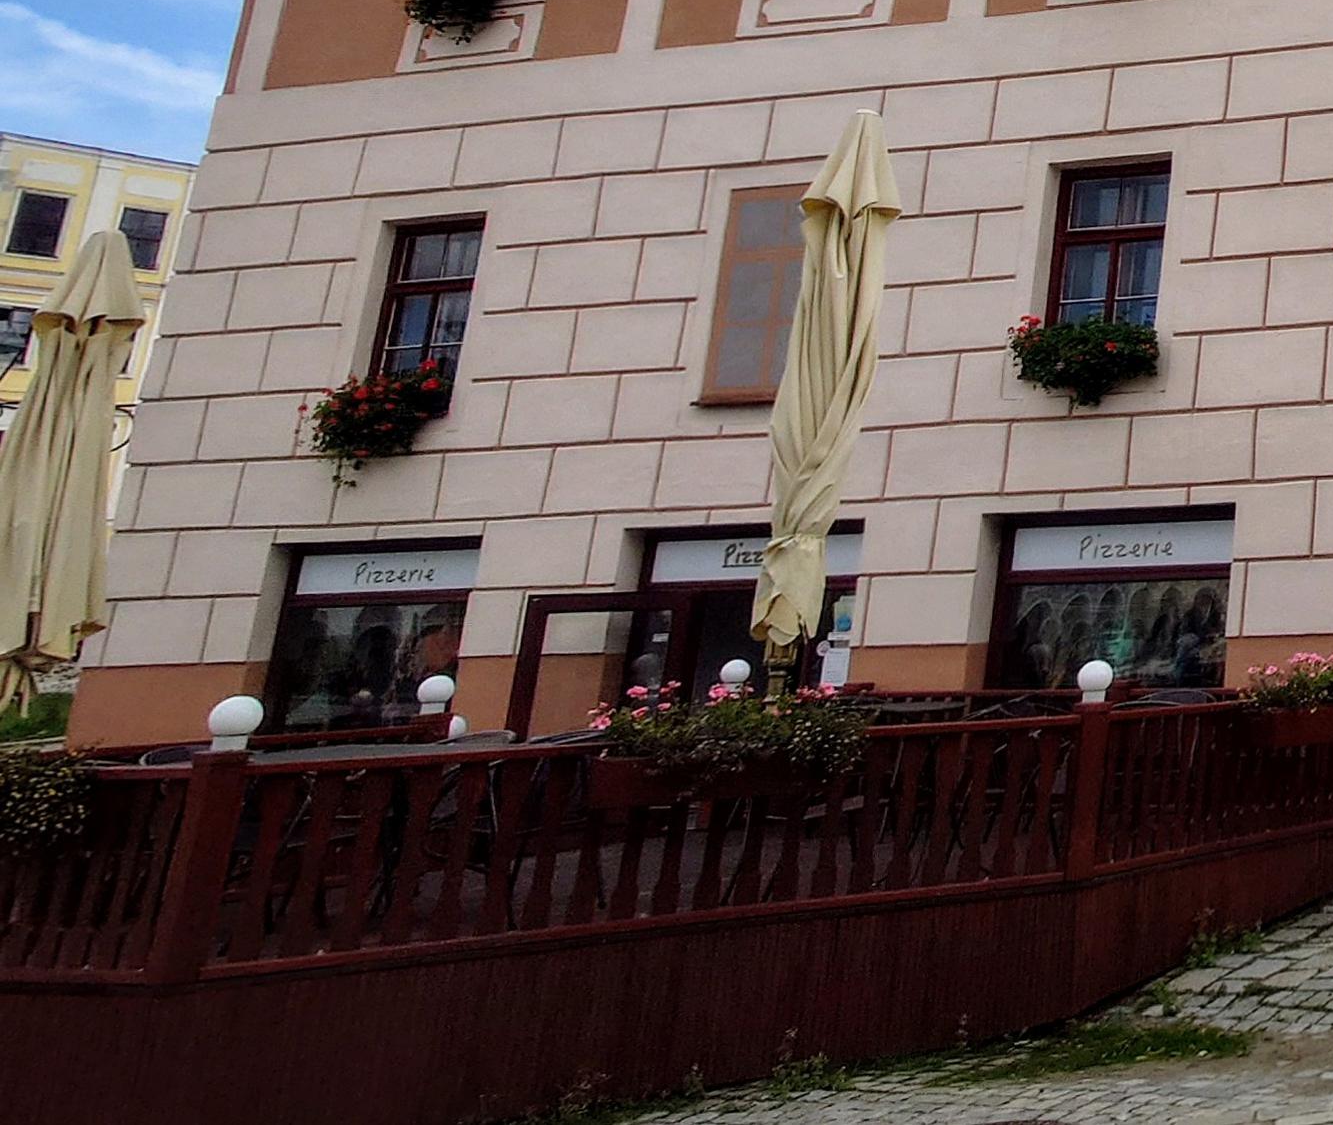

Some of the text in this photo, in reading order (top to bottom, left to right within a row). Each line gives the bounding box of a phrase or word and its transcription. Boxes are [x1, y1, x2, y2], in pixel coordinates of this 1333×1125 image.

[723, 542, 764, 567] Pizz
[1079, 531, 1173, 560] Pizzerie
[353, 558, 435, 584] Pizzerie
